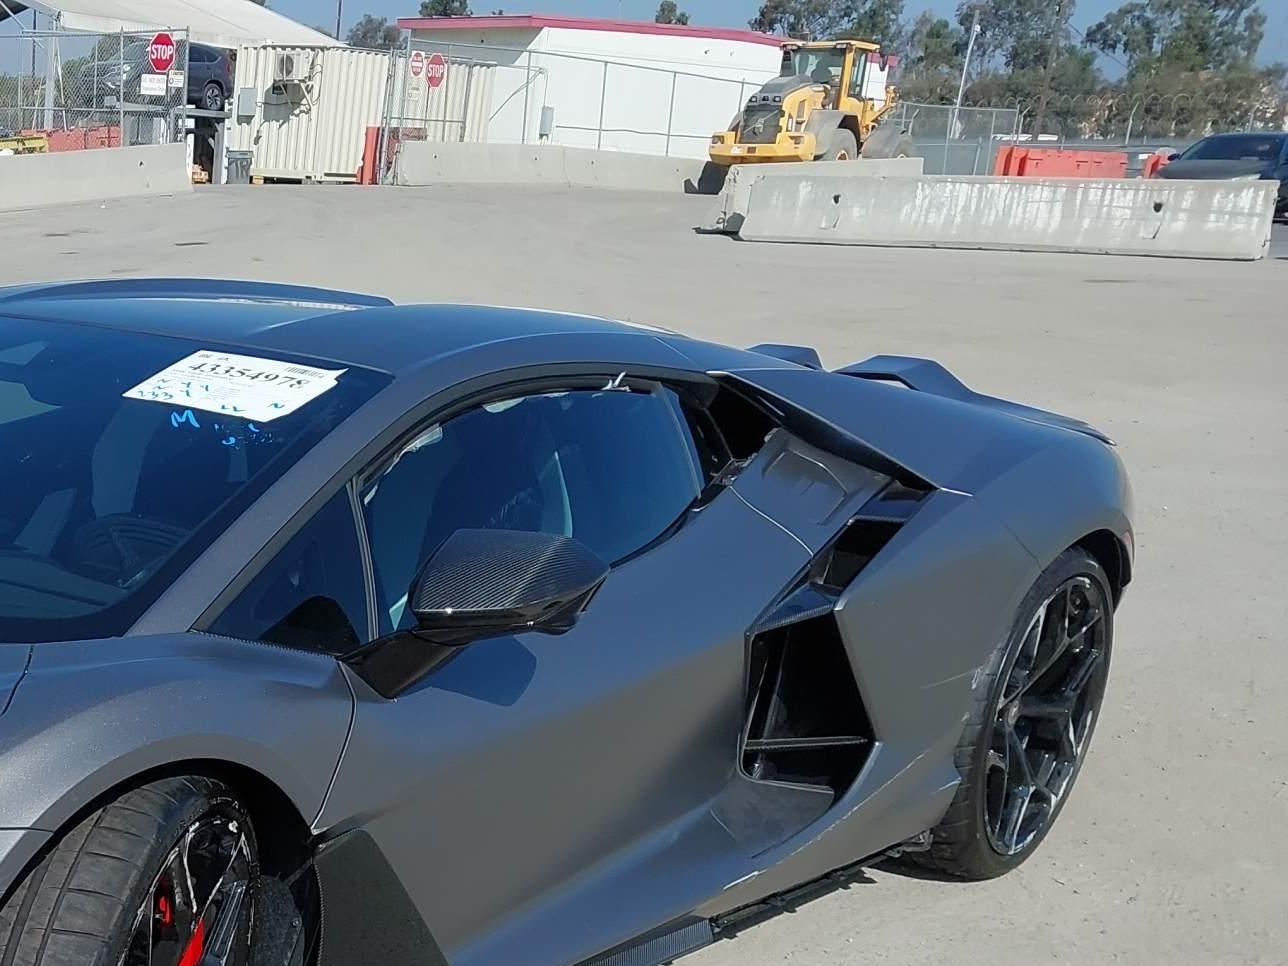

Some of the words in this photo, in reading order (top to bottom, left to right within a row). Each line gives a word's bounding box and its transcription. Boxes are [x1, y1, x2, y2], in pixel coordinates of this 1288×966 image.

[151, 44, 173, 60] STOP
[427, 63, 444, 78] STOP
[189, 362, 310, 389] 43354978
